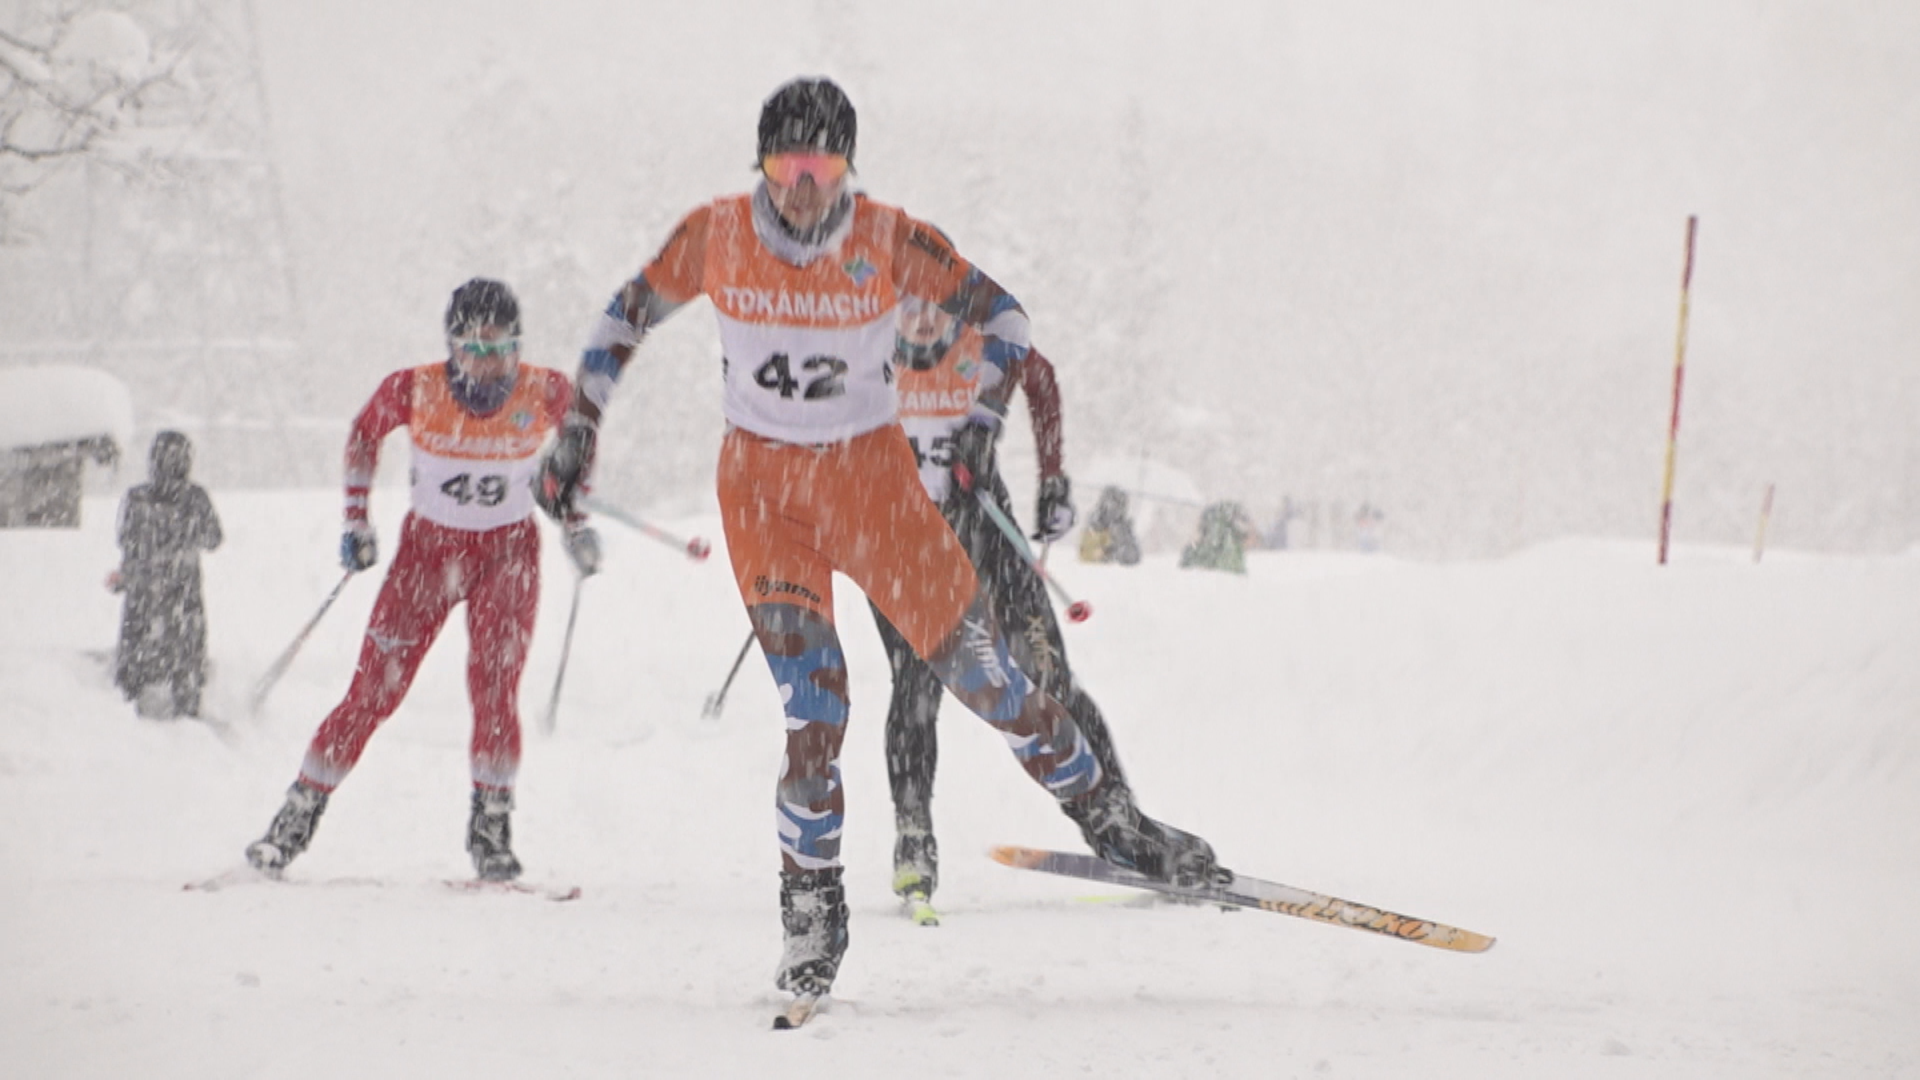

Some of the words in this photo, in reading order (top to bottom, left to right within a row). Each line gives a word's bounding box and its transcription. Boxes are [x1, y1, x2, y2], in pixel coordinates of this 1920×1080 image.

[723, 284, 880, 321] TOKAMACHI
[753, 352, 849, 400] 42
[440, 473, 507, 506] 49
